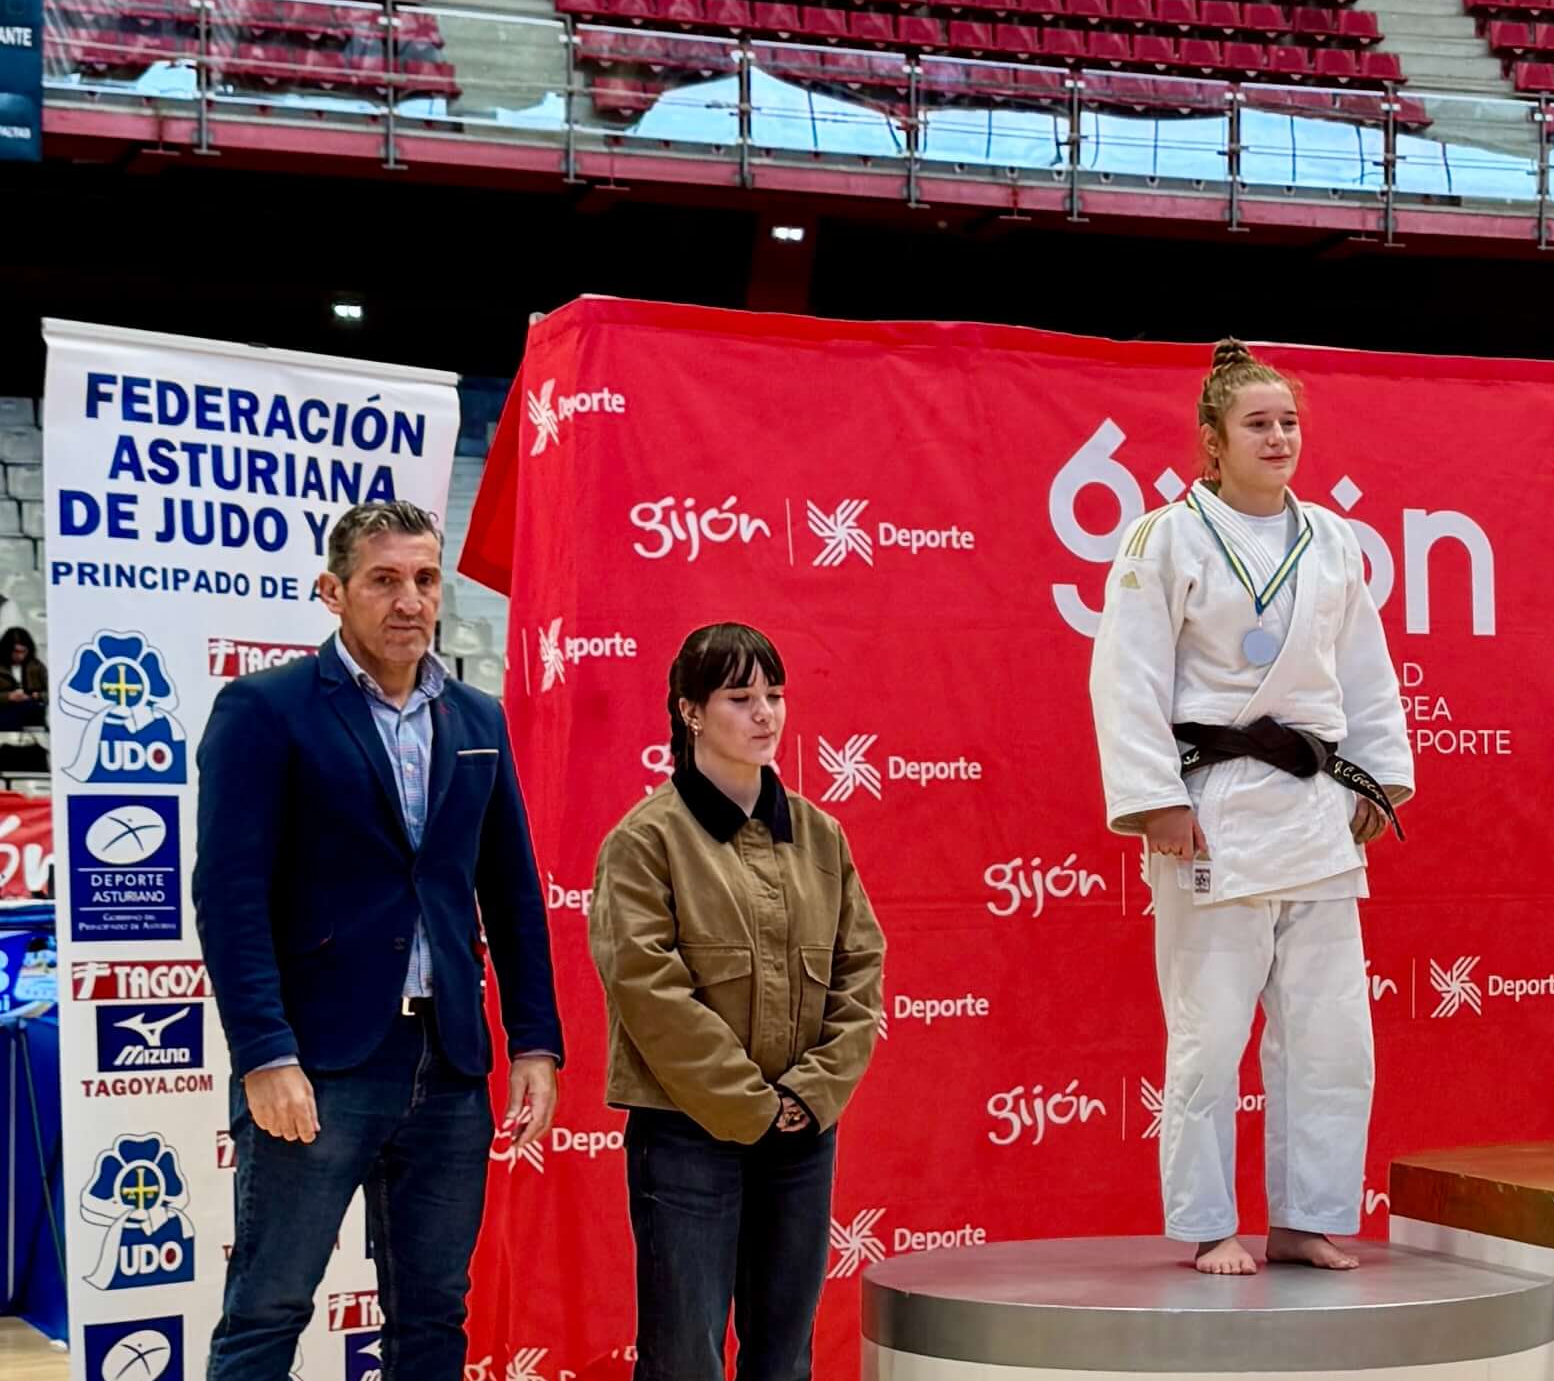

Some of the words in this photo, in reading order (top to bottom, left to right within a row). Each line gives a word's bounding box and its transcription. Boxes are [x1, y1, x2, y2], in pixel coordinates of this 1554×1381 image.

[86, 372, 426, 458] FEDERACIÓN
[109, 435, 397, 504] ASTURIANA
[59, 489, 139, 540] DE
[156, 497, 289, 553] JUDO
[303, 510, 330, 556] Y
[630, 495, 772, 561] gijón
[879, 522, 975, 553] Deporte
[51, 562, 249, 597] PRINCIPADO
[260, 575, 299, 601] DE
[888, 756, 982, 786] Deporte
[91, 873, 164, 887] DEPORTE
[92, 890, 166, 903] ASTURIANO
[984, 853, 1106, 917] gijón
[894, 994, 989, 1025] Deporte
[81, 1074, 213, 1098] TAGOYA.COM
[987, 1079, 1107, 1145] gijón
[893, 1223, 987, 1252] Deporte
